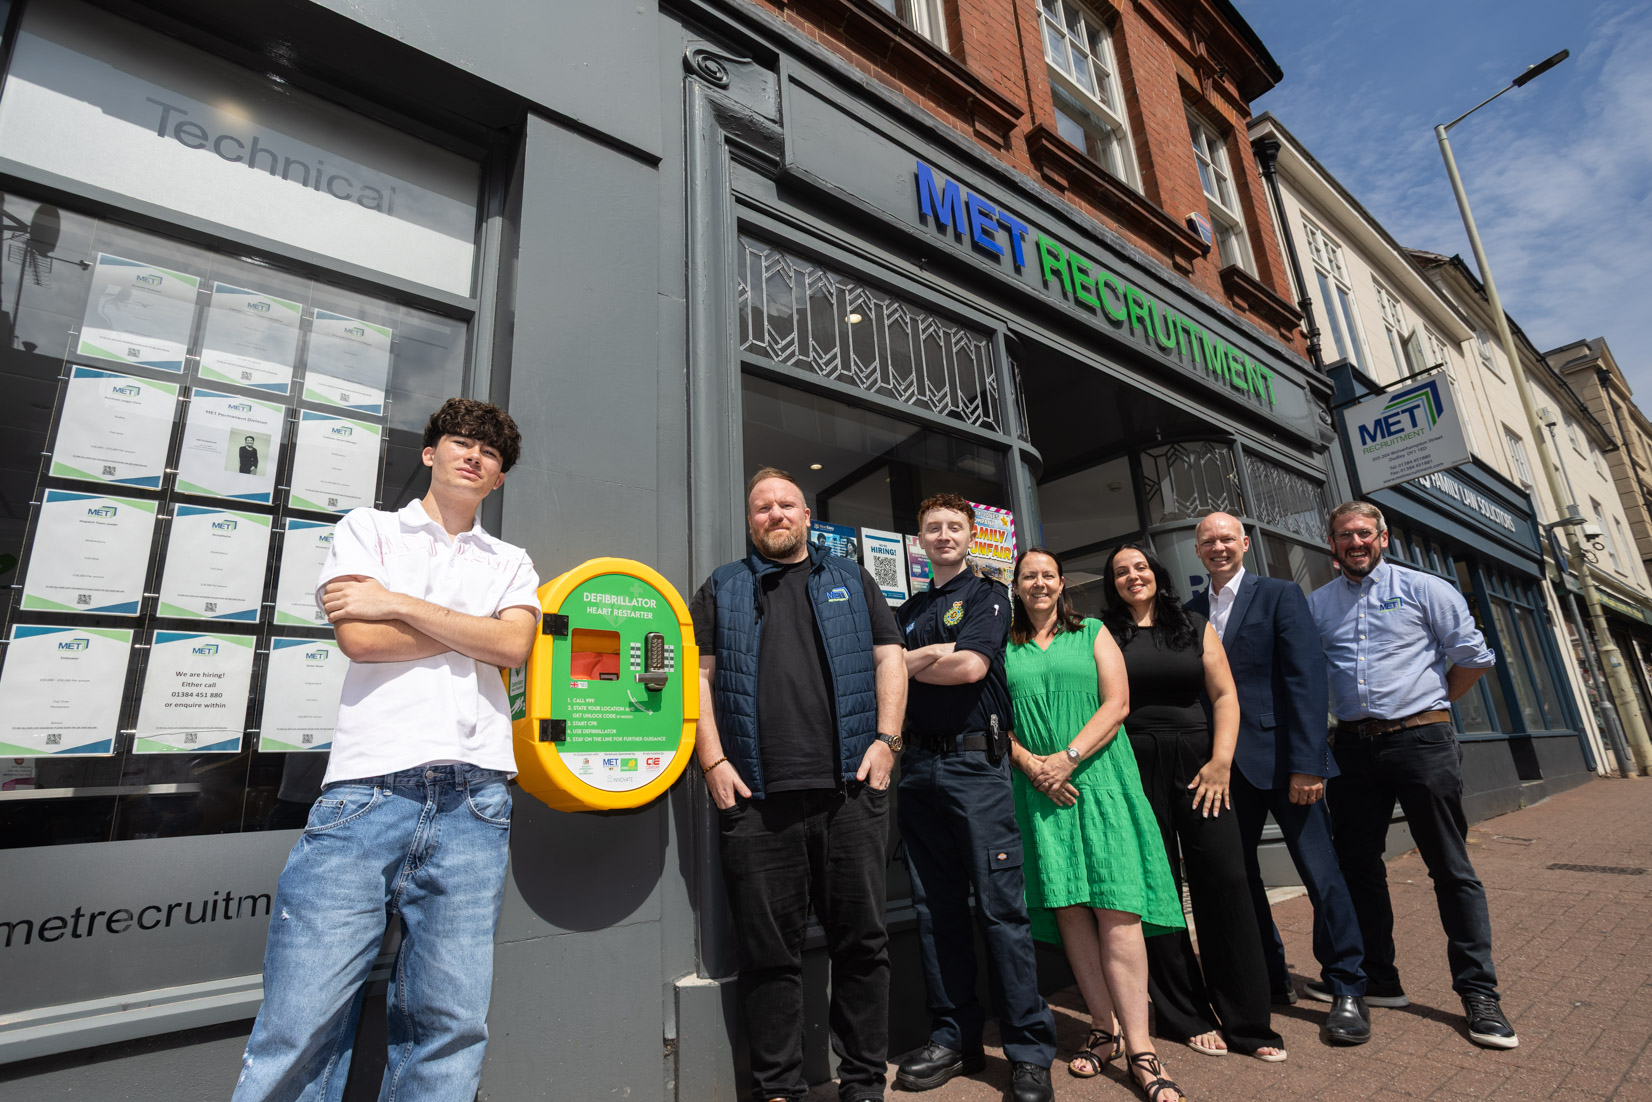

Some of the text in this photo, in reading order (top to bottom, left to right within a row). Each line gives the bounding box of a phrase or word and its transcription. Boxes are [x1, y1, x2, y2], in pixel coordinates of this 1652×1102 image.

[146, 96, 396, 216] Technical
[916, 160, 1277, 406] MET RECRUITMENT
[218, 412, 246, 421] Permanent
[1358, 404, 1421, 446] MET
[1362, 428, 1425, 455] RECRUITMENT
[1459, 485, 1479, 511] LAW
[1478, 497, 1516, 532] SOLICITORS
[973, 524, 1006, 543] AMILY
[871, 546, 896, 556] HIRING!
[970, 541, 1012, 560] UNFAIR
[584, 592, 656, 608] DEFIBRILLATOR
[826, 591, 845, 599] MET
[587, 606, 653, 619] HEART RESTARTER
[1380, 602, 1396, 611] MET
[0, 890, 271, 947] metrecruitm
